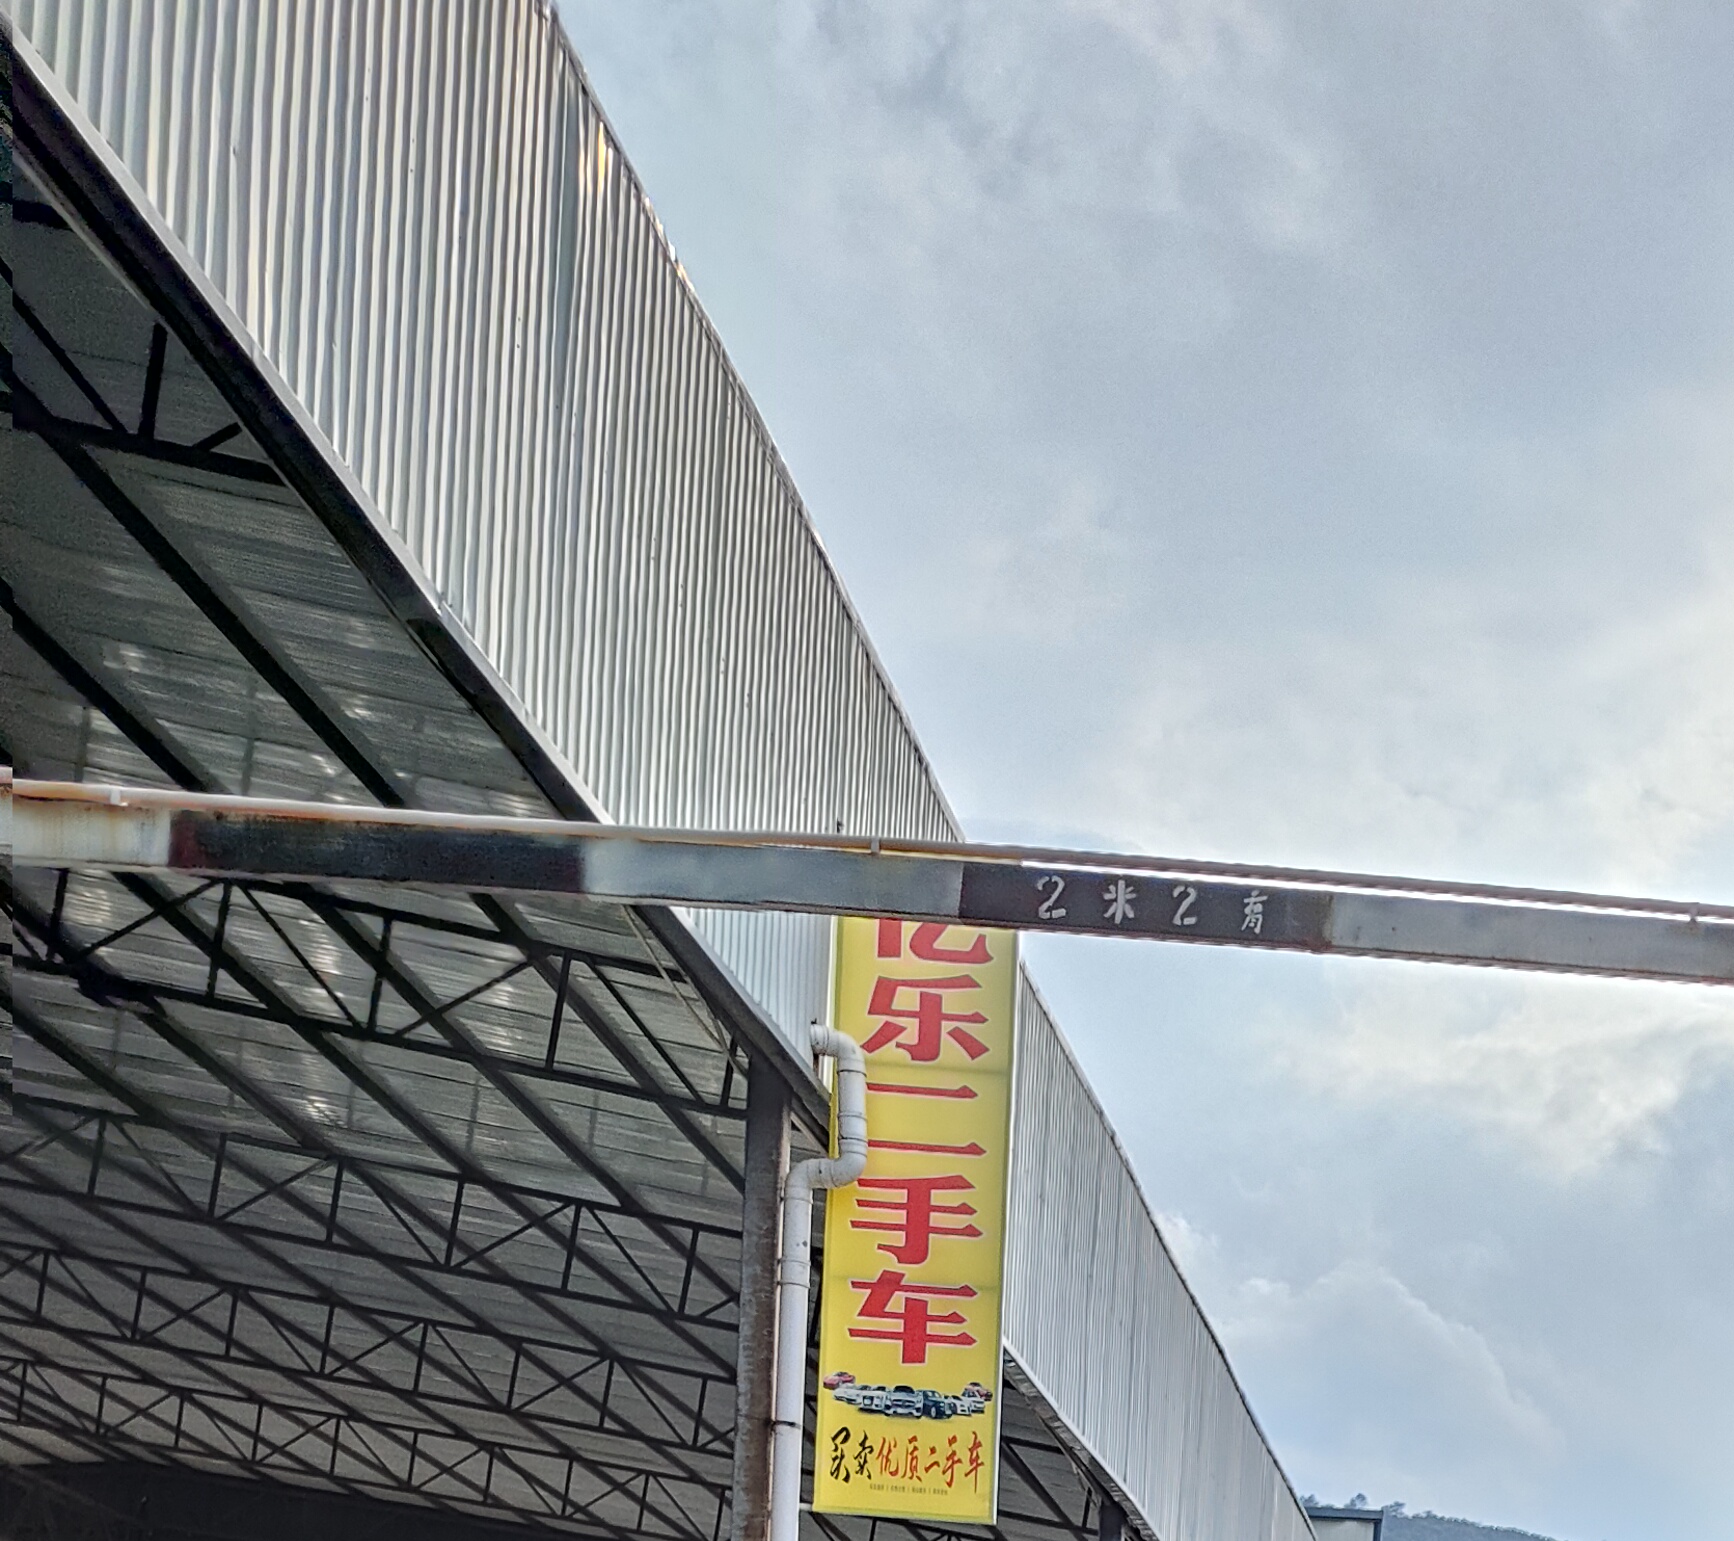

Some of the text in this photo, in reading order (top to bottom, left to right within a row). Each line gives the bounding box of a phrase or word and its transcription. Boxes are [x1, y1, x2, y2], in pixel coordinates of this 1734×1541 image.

[830, 1426, 985, 1494] 买卖优质二手车
